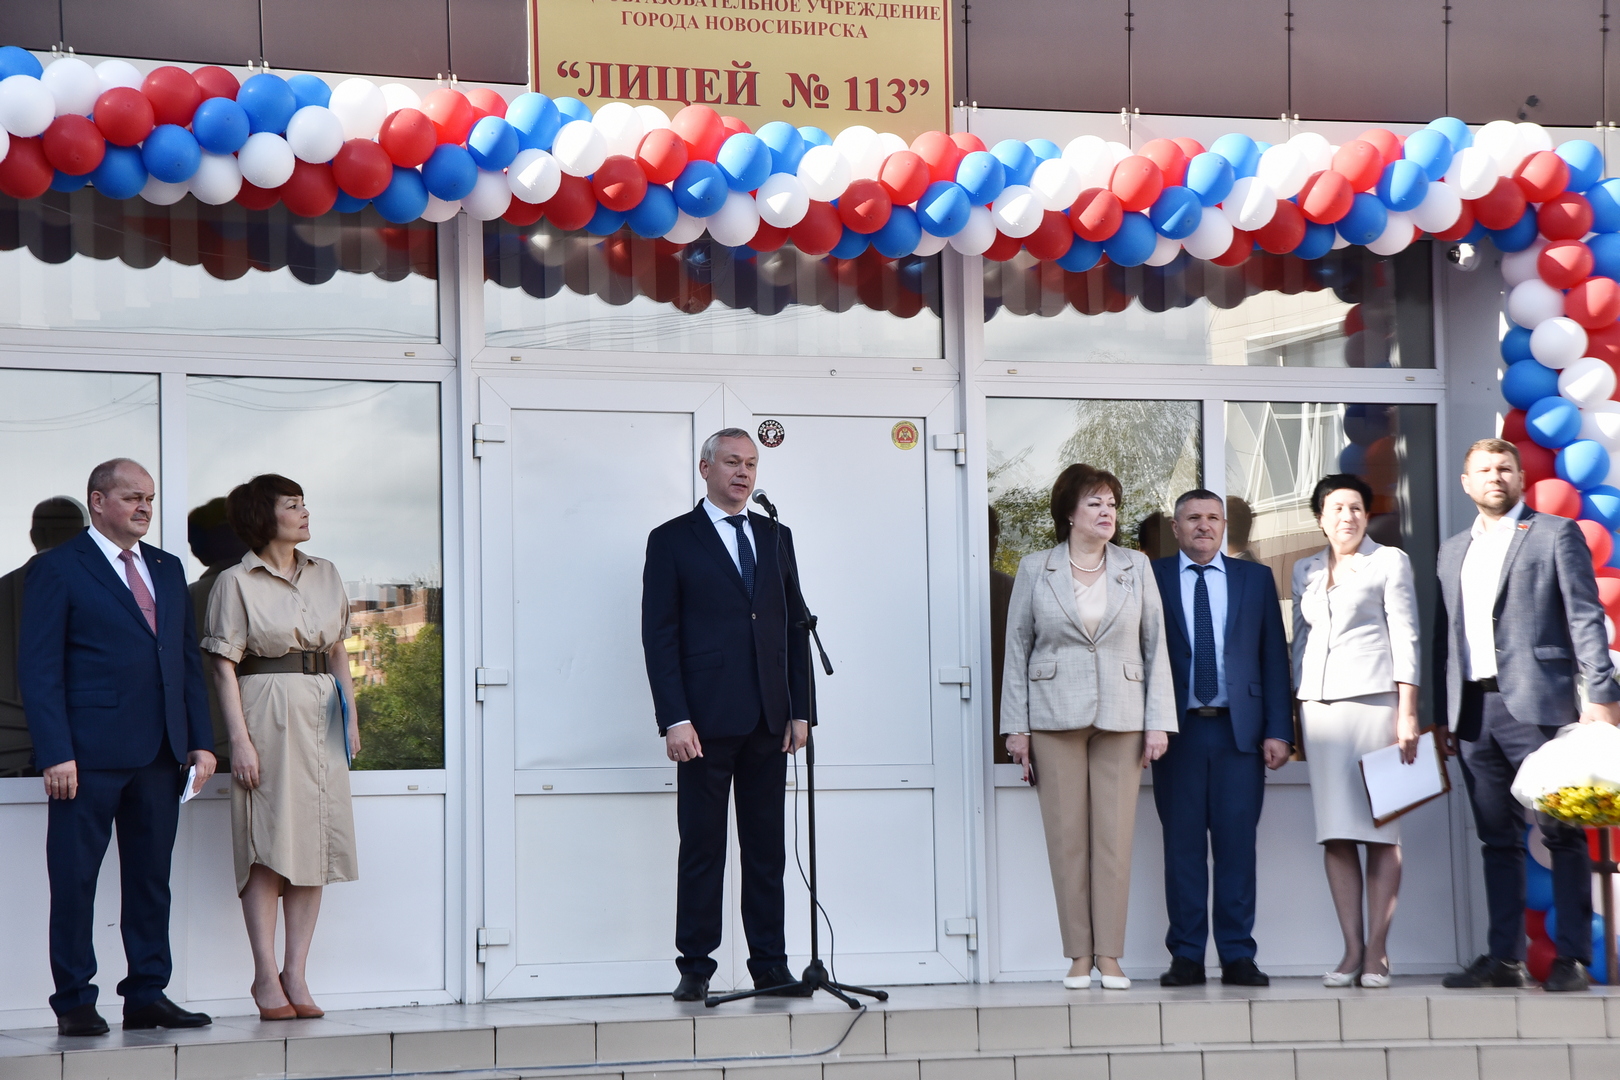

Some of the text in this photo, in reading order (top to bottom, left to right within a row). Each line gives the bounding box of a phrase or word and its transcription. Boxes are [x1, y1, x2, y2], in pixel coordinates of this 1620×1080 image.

[807, 0, 941, 21] УЧРЕЖДЕНИЕ
[621, 11, 869, 39] ГОРОДА НОВОСИБИРСКА
[782, 72, 830, 109] №
